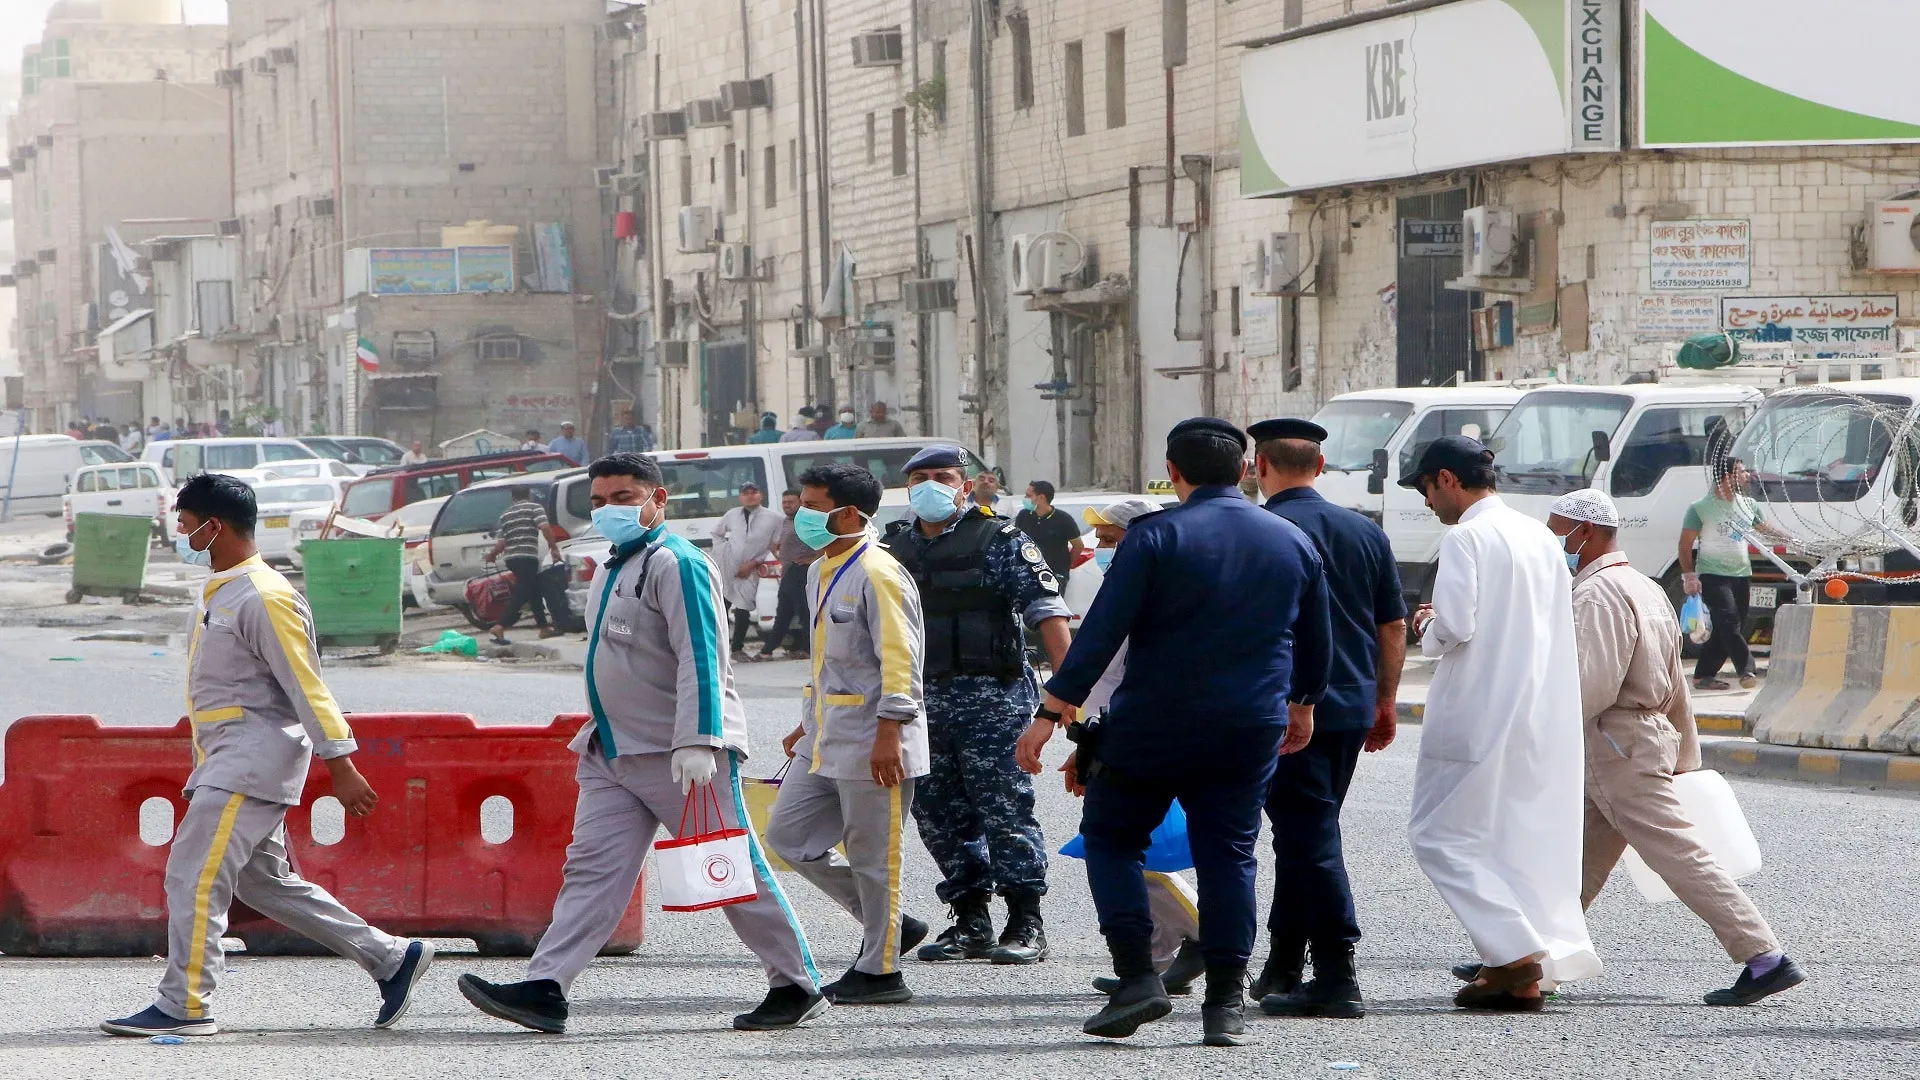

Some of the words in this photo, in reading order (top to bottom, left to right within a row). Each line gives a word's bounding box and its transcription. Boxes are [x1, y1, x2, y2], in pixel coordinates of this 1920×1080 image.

[1365, 39, 1407, 121] KBE
[1410, 224, 1463, 234] WESTE
[1433, 233, 1463, 243] UNI
[1770, 303, 1805, 323] عمرة
[1808, 299, 1859, 324] رحمانية
[1860, 300, 1895, 319] حملة
